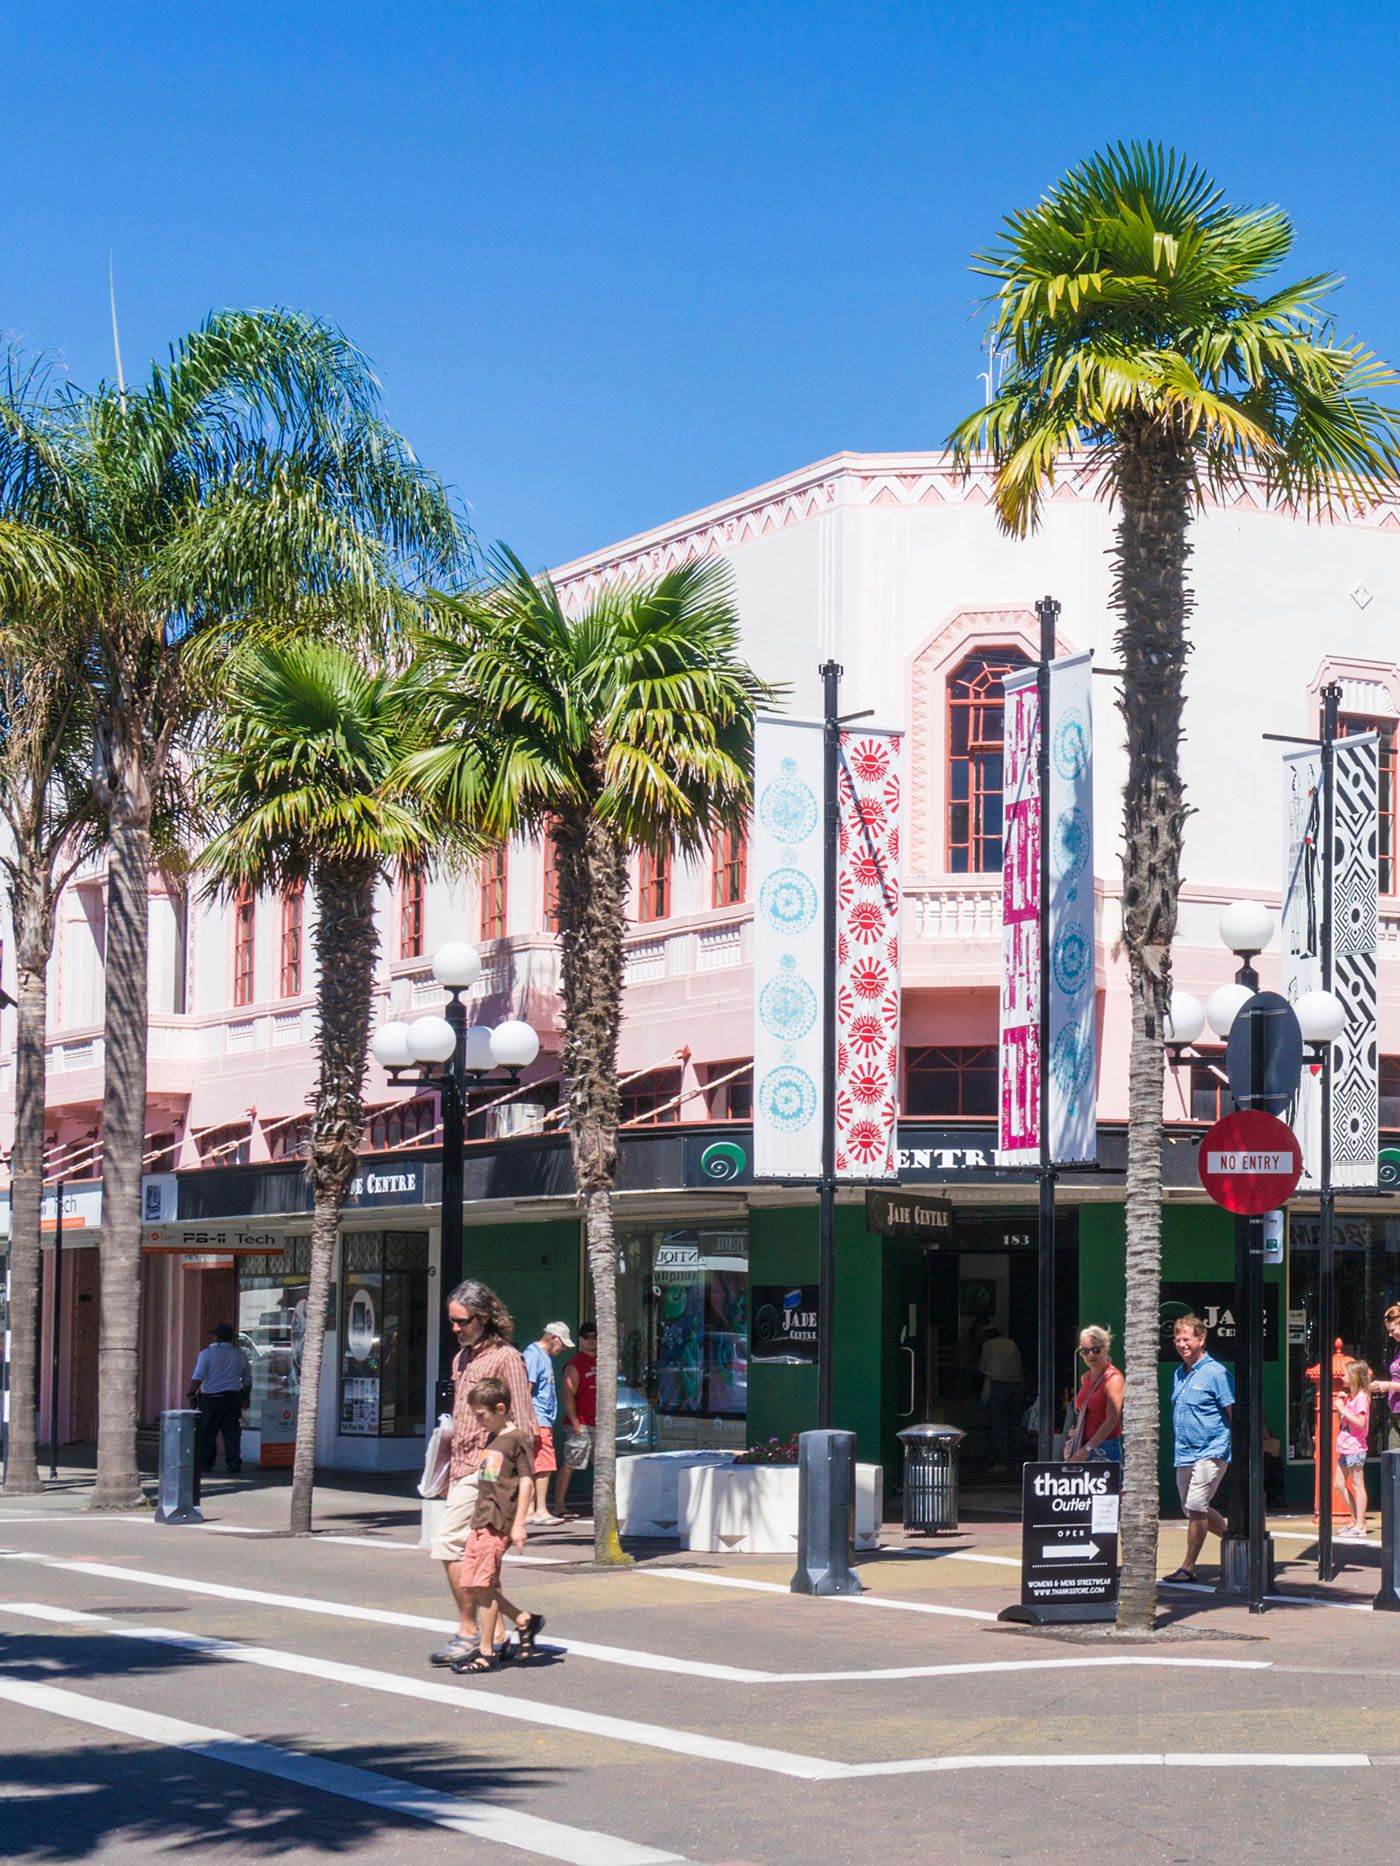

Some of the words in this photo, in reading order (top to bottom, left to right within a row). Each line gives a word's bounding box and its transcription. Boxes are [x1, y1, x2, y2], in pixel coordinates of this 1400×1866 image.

[1220, 1155, 1236, 1170] NO
[1242, 1155, 1280, 1170] ENTRY
[366, 1173, 416, 1194] CENTRE
[888, 1203, 910, 1225] JADE
[914, 1206, 949, 1227] CENTRE
[234, 1233, 275, 1244] Tech
[1003, 1234, 1029, 1246] 183
[782, 1309, 817, 1331] JADE
[789, 1330, 817, 1340] CENTRE
[1052, 1498, 1092, 1512] Outlet
[1057, 1530, 1085, 1538] OPEN
[1028, 1580, 1053, 1588] WOMENS
[1054, 1580, 1059, 1588] &
[1060, 1579, 1076, 1587] MENS
[1077, 1578, 1111, 1586] STREETWEAR
